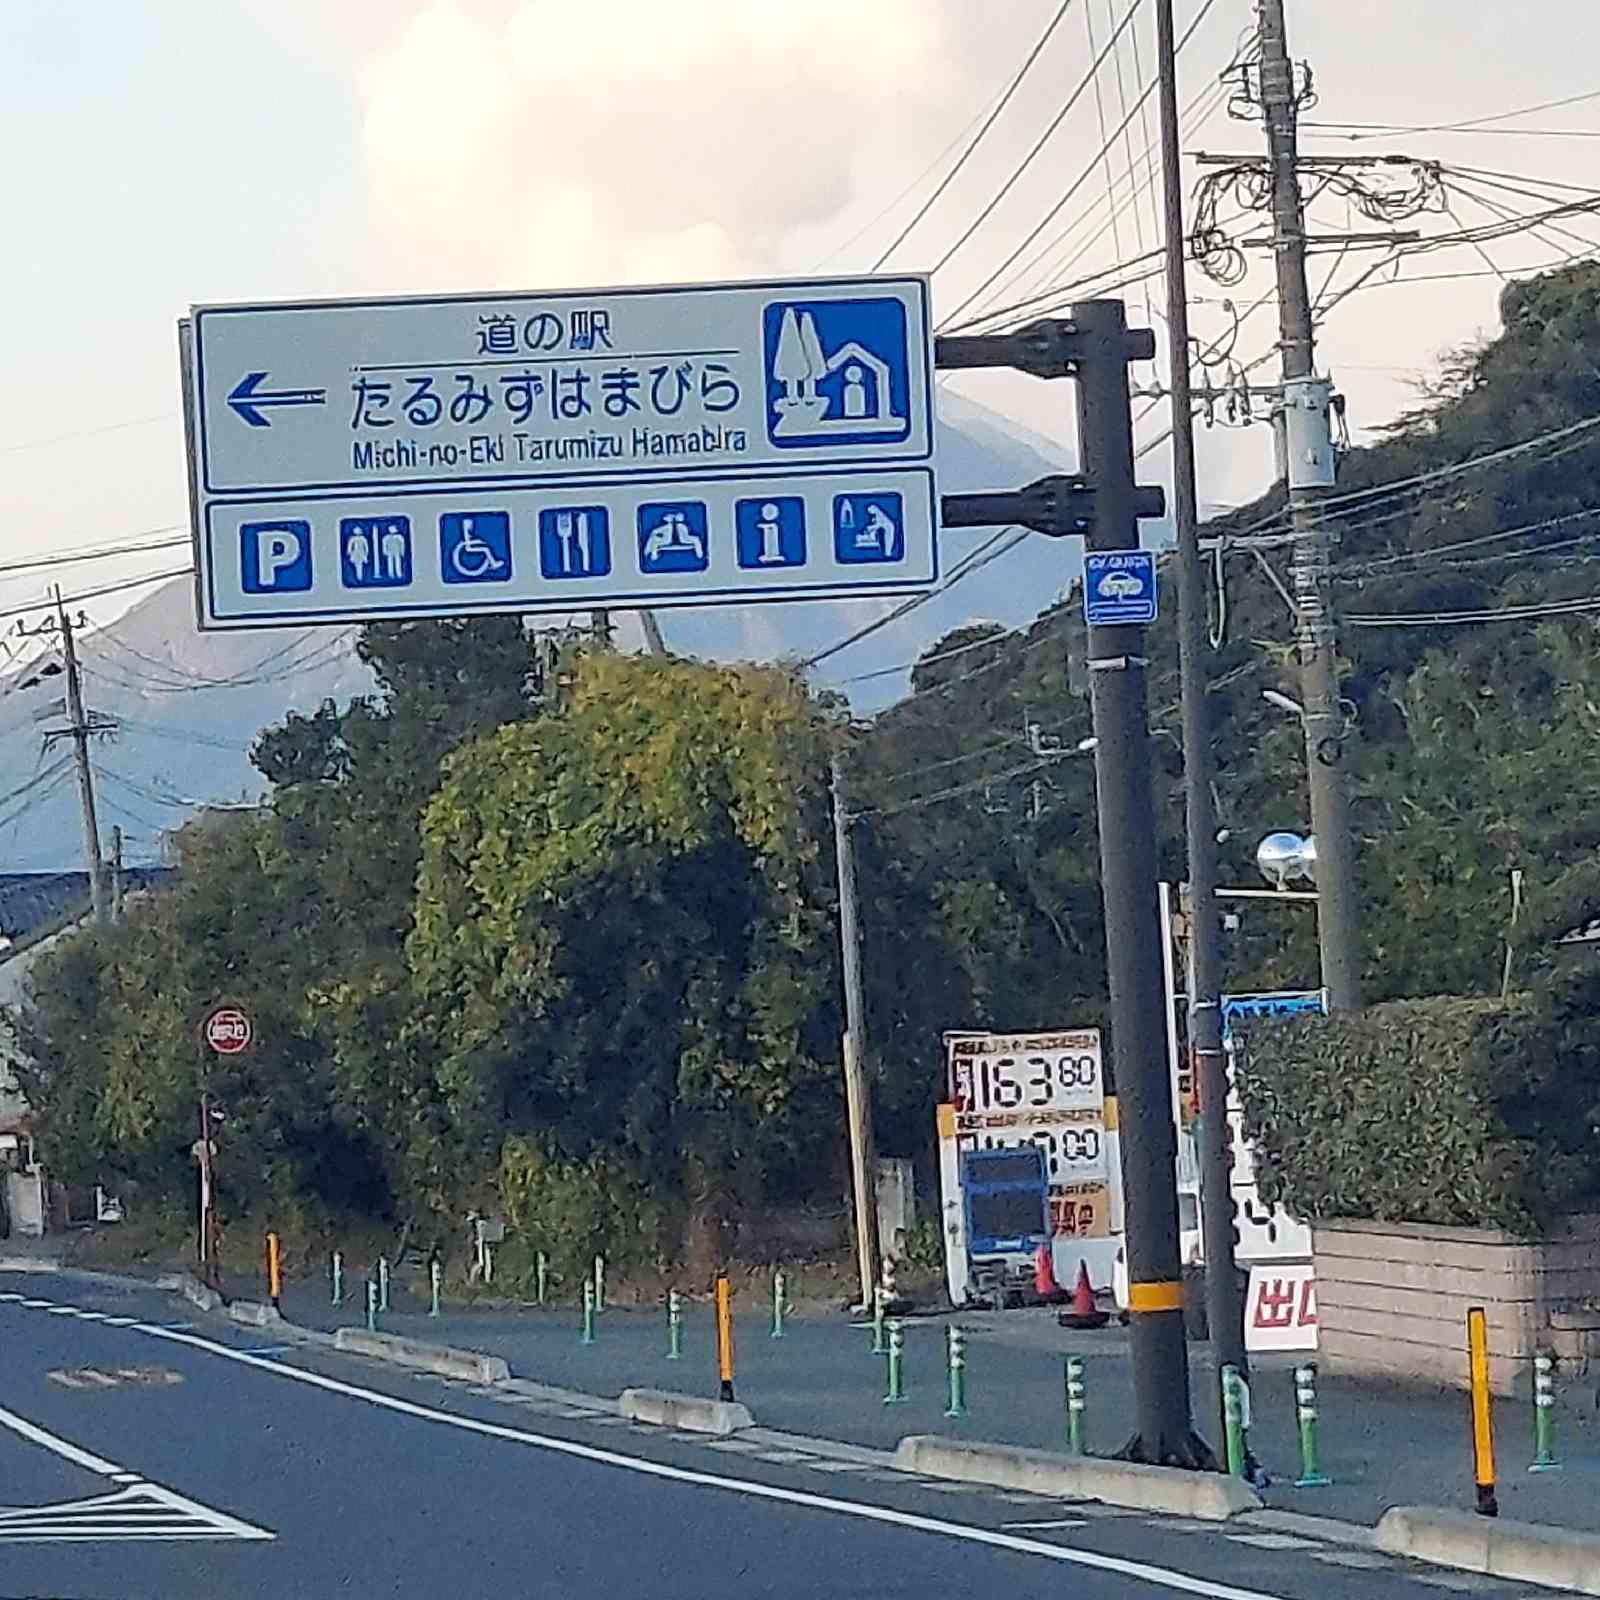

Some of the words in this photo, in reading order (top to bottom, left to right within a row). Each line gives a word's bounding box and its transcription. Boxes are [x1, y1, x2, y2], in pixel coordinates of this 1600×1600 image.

[475, 309, 614, 355] 道の駅
[351, 360, 741, 429] たるみずはまびら
[513, 429, 622, 463] Tarumizu
[257, 530, 300, 586] P
